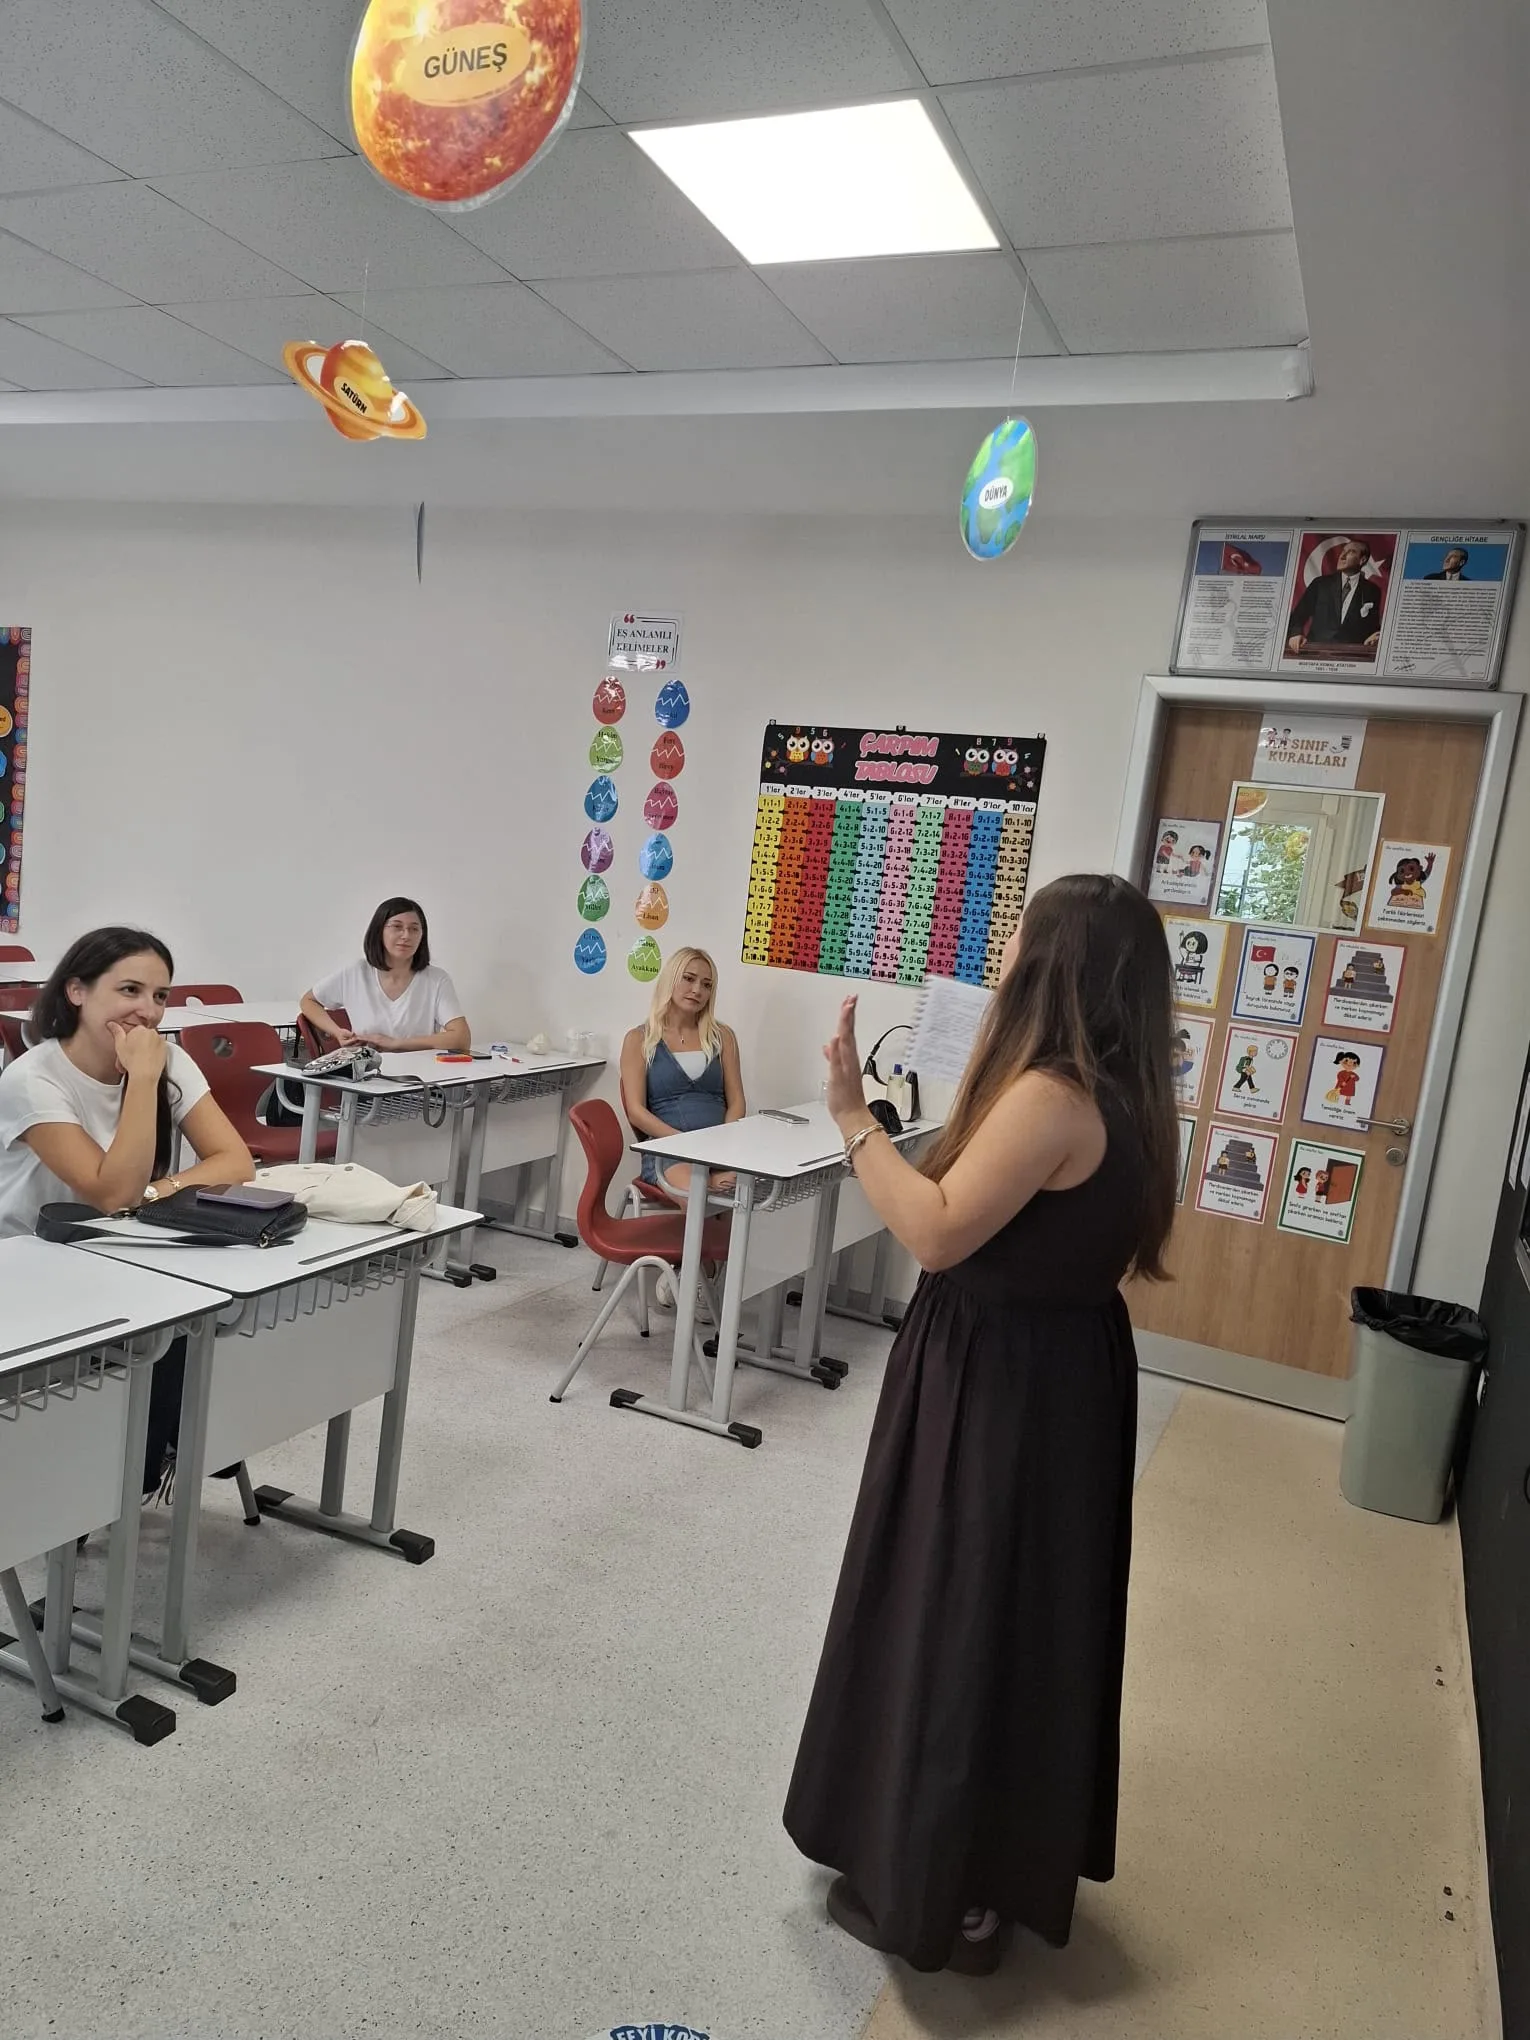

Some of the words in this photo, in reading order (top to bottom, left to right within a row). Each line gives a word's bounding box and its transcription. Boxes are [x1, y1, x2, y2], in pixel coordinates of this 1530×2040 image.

[424, 43, 507, 78] GÜNEŞ
[341, 382, 367, 413] SATÜRN
[984, 485, 1008, 502] DÜNYA
[617, 628, 628, 639] EŞ
[630, 629, 672, 640] ANLAMLI
[860, 732, 940, 758] ÇARPIM
[1290, 738, 1329, 752] SINIF
[1268, 750, 1347, 768] KURALLARI
[855, 760, 939, 784] TABLOSU
